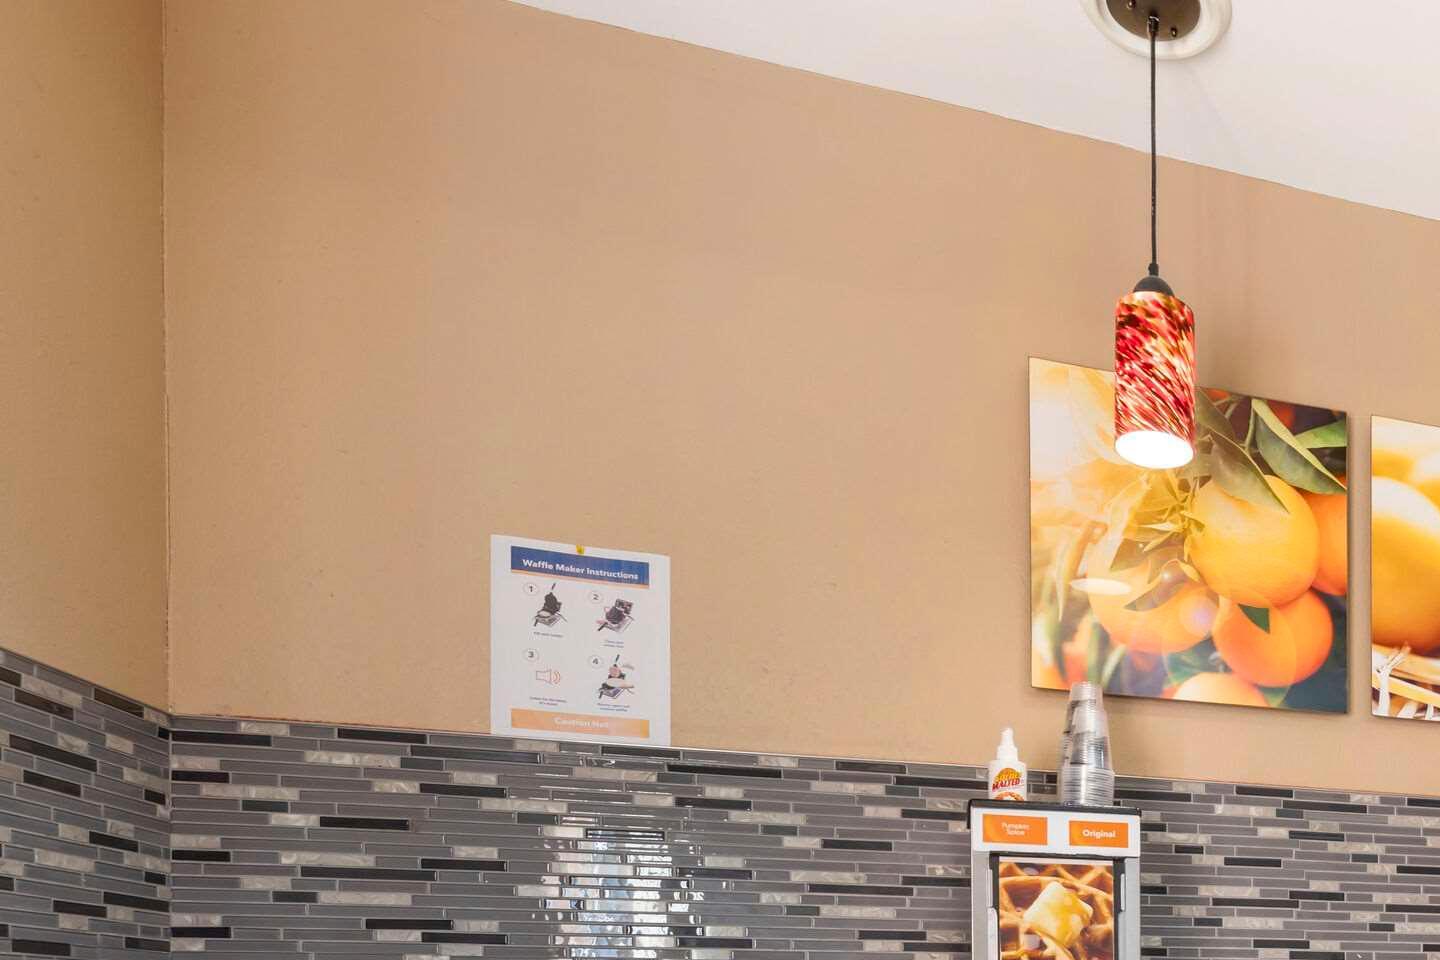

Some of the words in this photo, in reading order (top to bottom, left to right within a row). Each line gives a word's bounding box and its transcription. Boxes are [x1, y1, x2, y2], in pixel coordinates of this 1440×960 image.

[523, 559, 554, 570] Waffle
[555, 564, 584, 574] Maker
[586, 567, 639, 580] Instructions
[992, 777, 1021, 792] MALTED
[1082, 829, 1116, 840] Original
